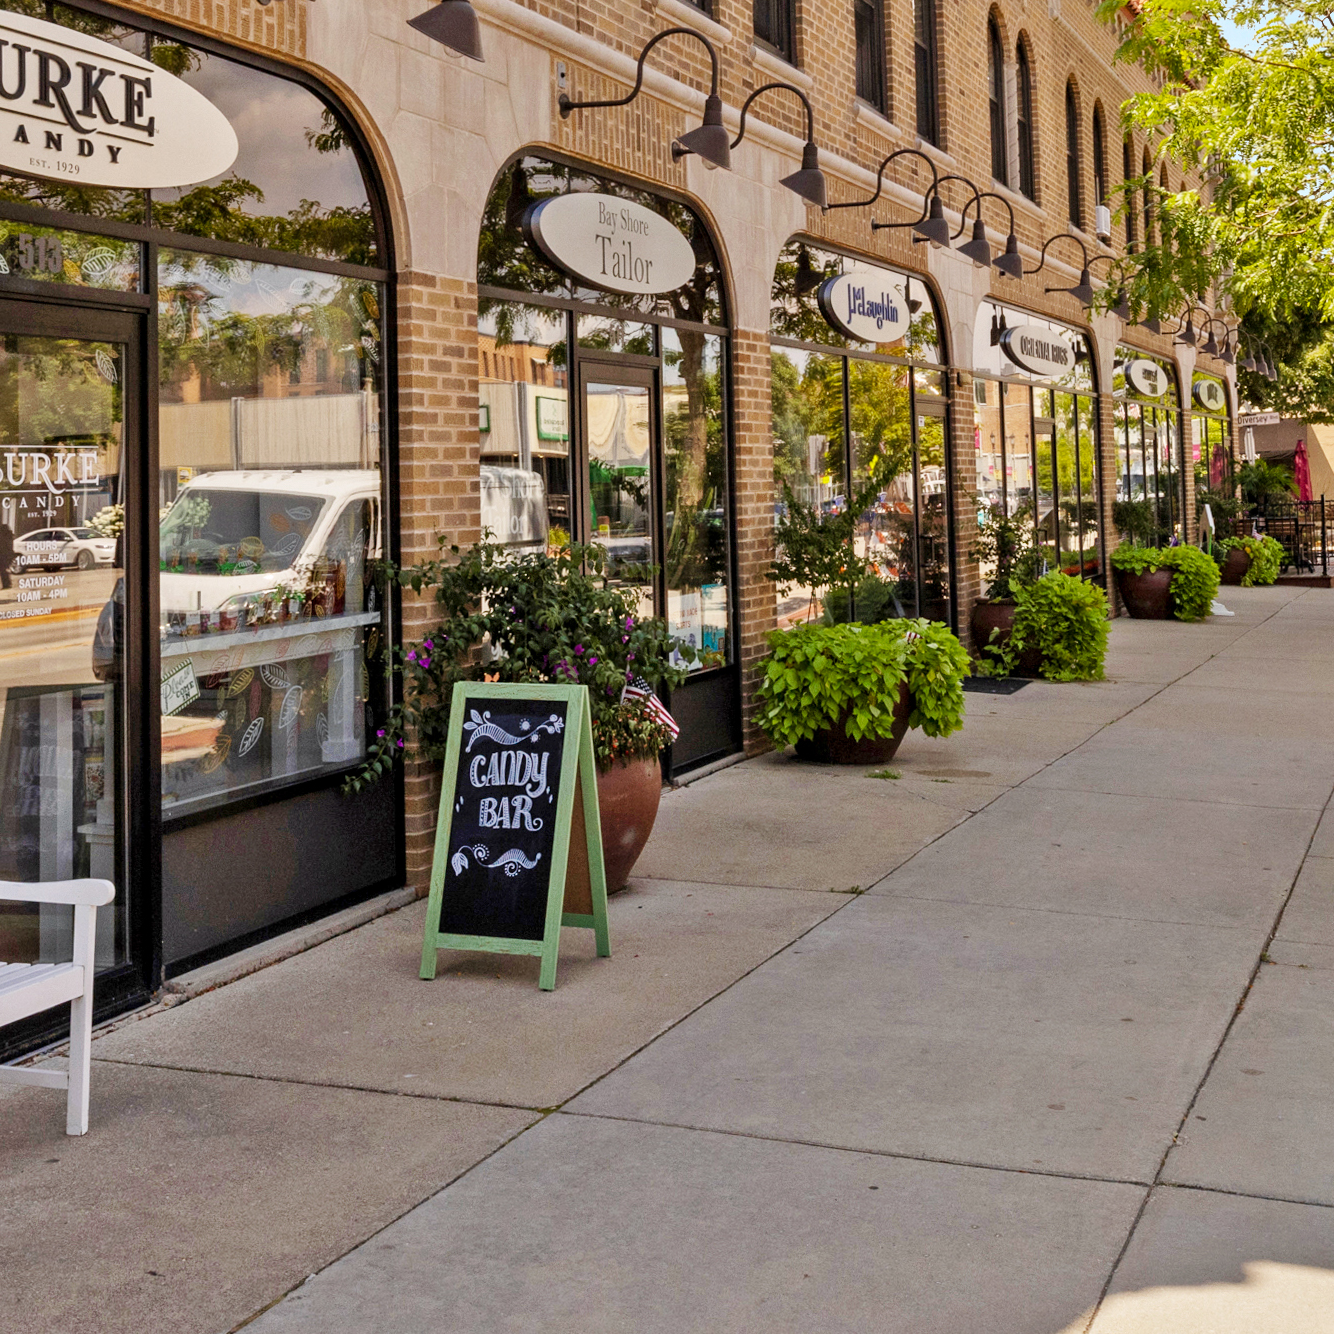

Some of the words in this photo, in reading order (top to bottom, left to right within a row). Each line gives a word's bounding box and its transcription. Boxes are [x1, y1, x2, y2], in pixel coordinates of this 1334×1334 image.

[29, 157, 51, 169] EST.
[56, 161, 80, 175] 1929
[598, 201, 618, 235] Bay
[620, 208, 649, 236] Shore
[18, 233, 63, 273] 513
[595, 234, 653, 285] Tailor
[1238, 416, 1268, 424] Diversey
[501, 469, 544, 498] Shore
[2, 496, 80, 509] CANDY
[27, 540, 57, 551] HOURS
[15, 555, 41, 566] 10AM
[48, 552, 67, 564] 5PM
[19, 575, 65, 589] SATURDAY
[16, 591, 41, 603] 10AM
[48, 588, 67, 600] 4PM
[26, 607, 53, 617] SUNDAY
[176, 680, 195, 698] COME
[470, 750, 549, 798] CANDY
[479, 795, 543, 831] BAR
